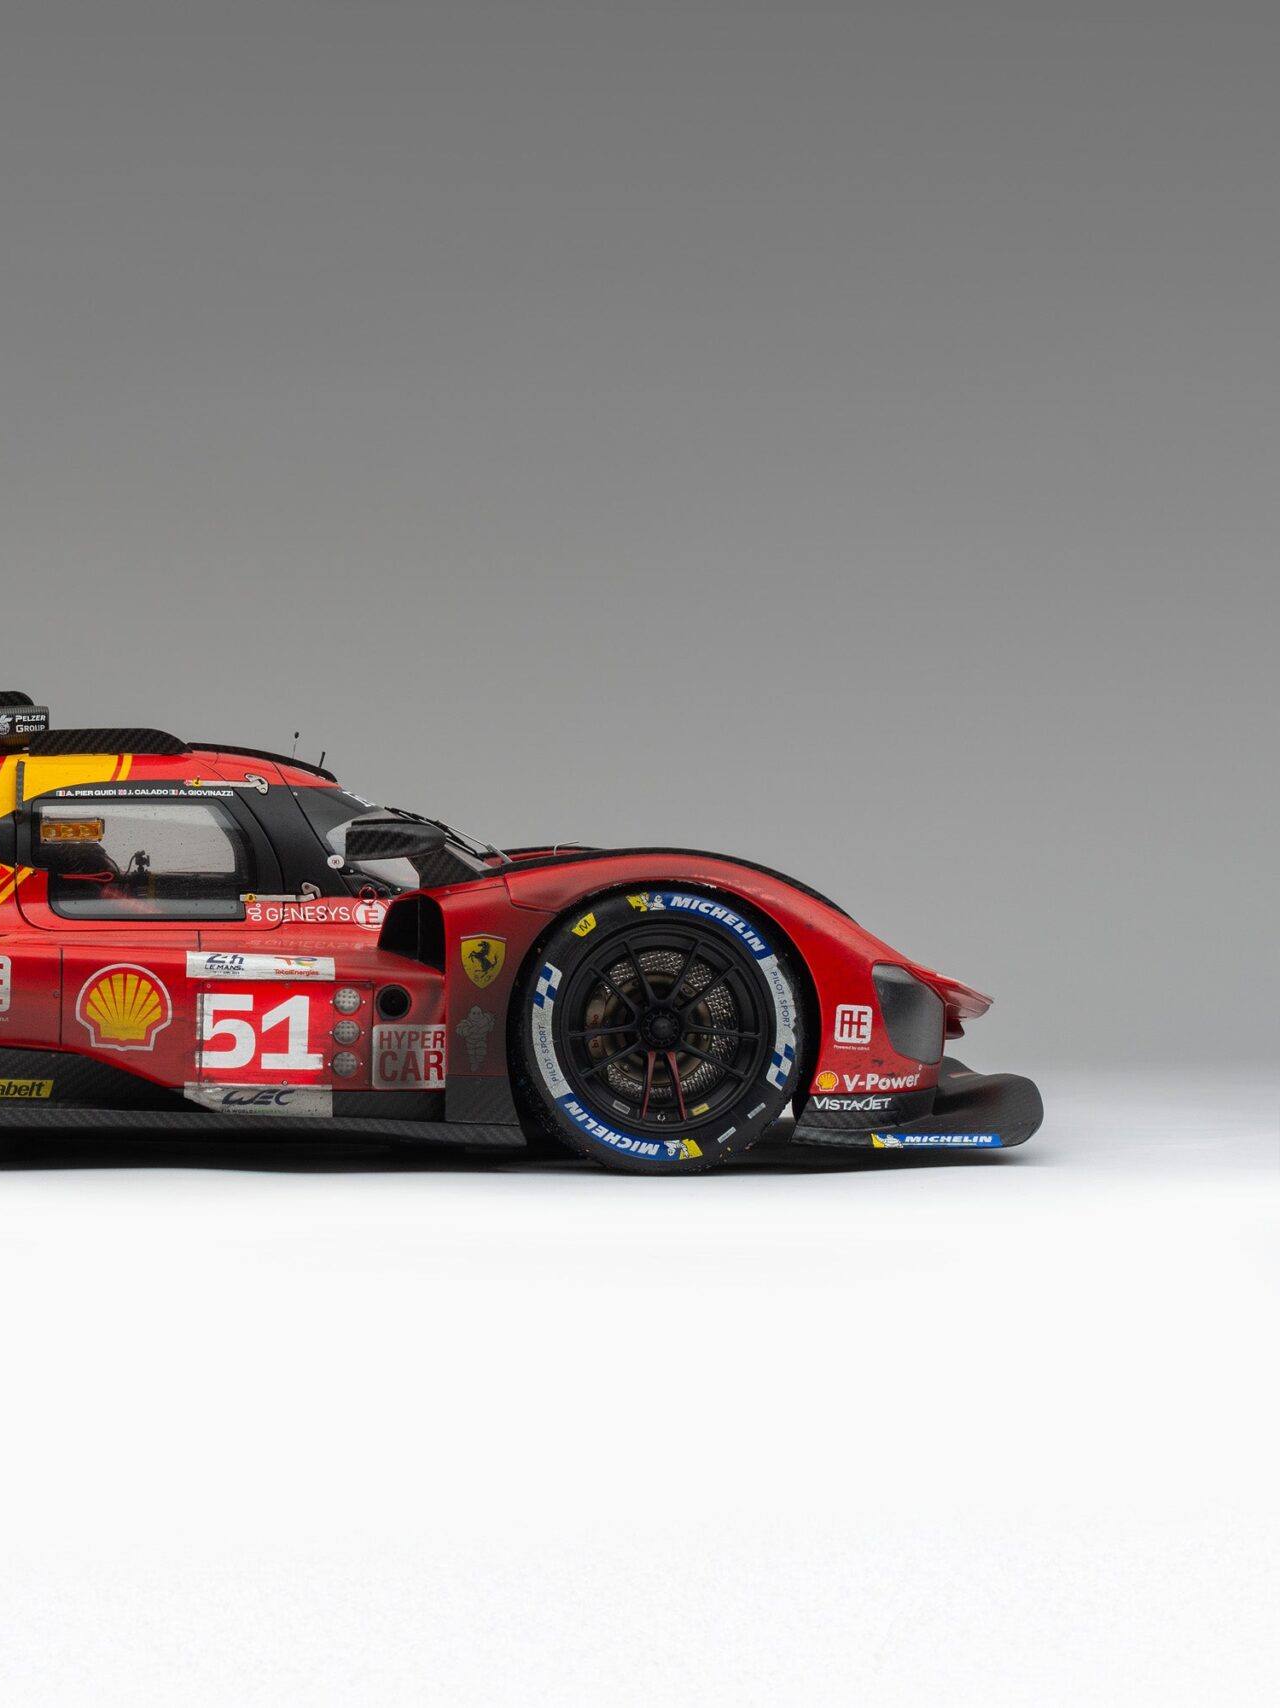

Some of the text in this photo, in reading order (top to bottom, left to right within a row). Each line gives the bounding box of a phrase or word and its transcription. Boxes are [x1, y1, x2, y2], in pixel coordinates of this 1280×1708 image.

[188, 789, 234, 797] GIOVINAZZI
[266, 906, 351, 922] GENESYS
[578, 919, 591, 932] M
[670, 895, 766, 953] MICHELIN
[770, 970, 792, 1030] PILOT SPORT
[196, 993, 324, 1070] 51
[379, 1030, 445, 1049] HYPER
[539, 1025, 558, 1083] PILOT SPORT
[379, 1050, 444, 1082] CAR
[843, 1073, 920, 1091] V-Power
[222, 1089, 296, 1106] WEC
[564, 1100, 661, 1156] MICHELIN
[904, 1135, 993, 1143] MICHELIN
